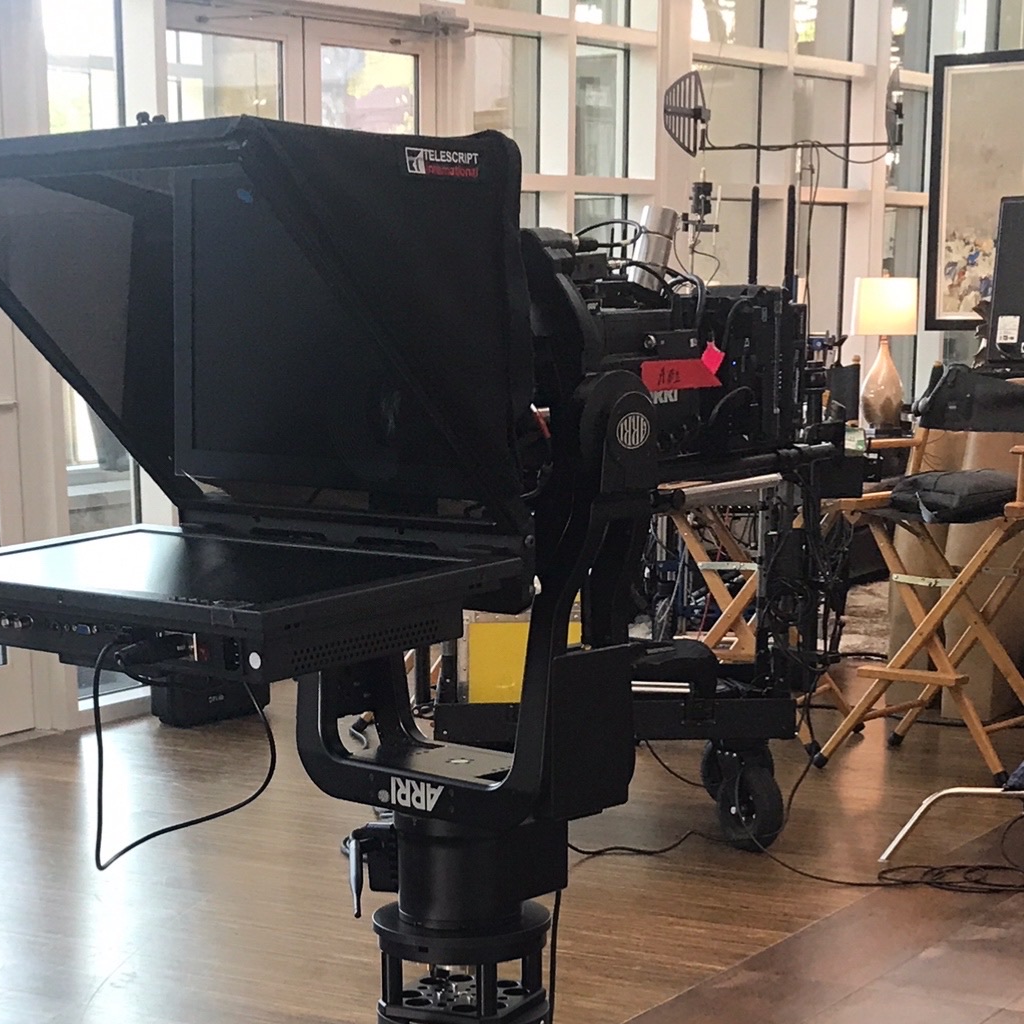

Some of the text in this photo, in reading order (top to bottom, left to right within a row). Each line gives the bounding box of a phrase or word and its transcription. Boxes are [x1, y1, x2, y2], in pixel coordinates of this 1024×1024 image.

[423, 149, 479, 165] TELESCRIPT
[650, 389, 678, 405] RRI
[390, 776, 445, 812] ARRI
